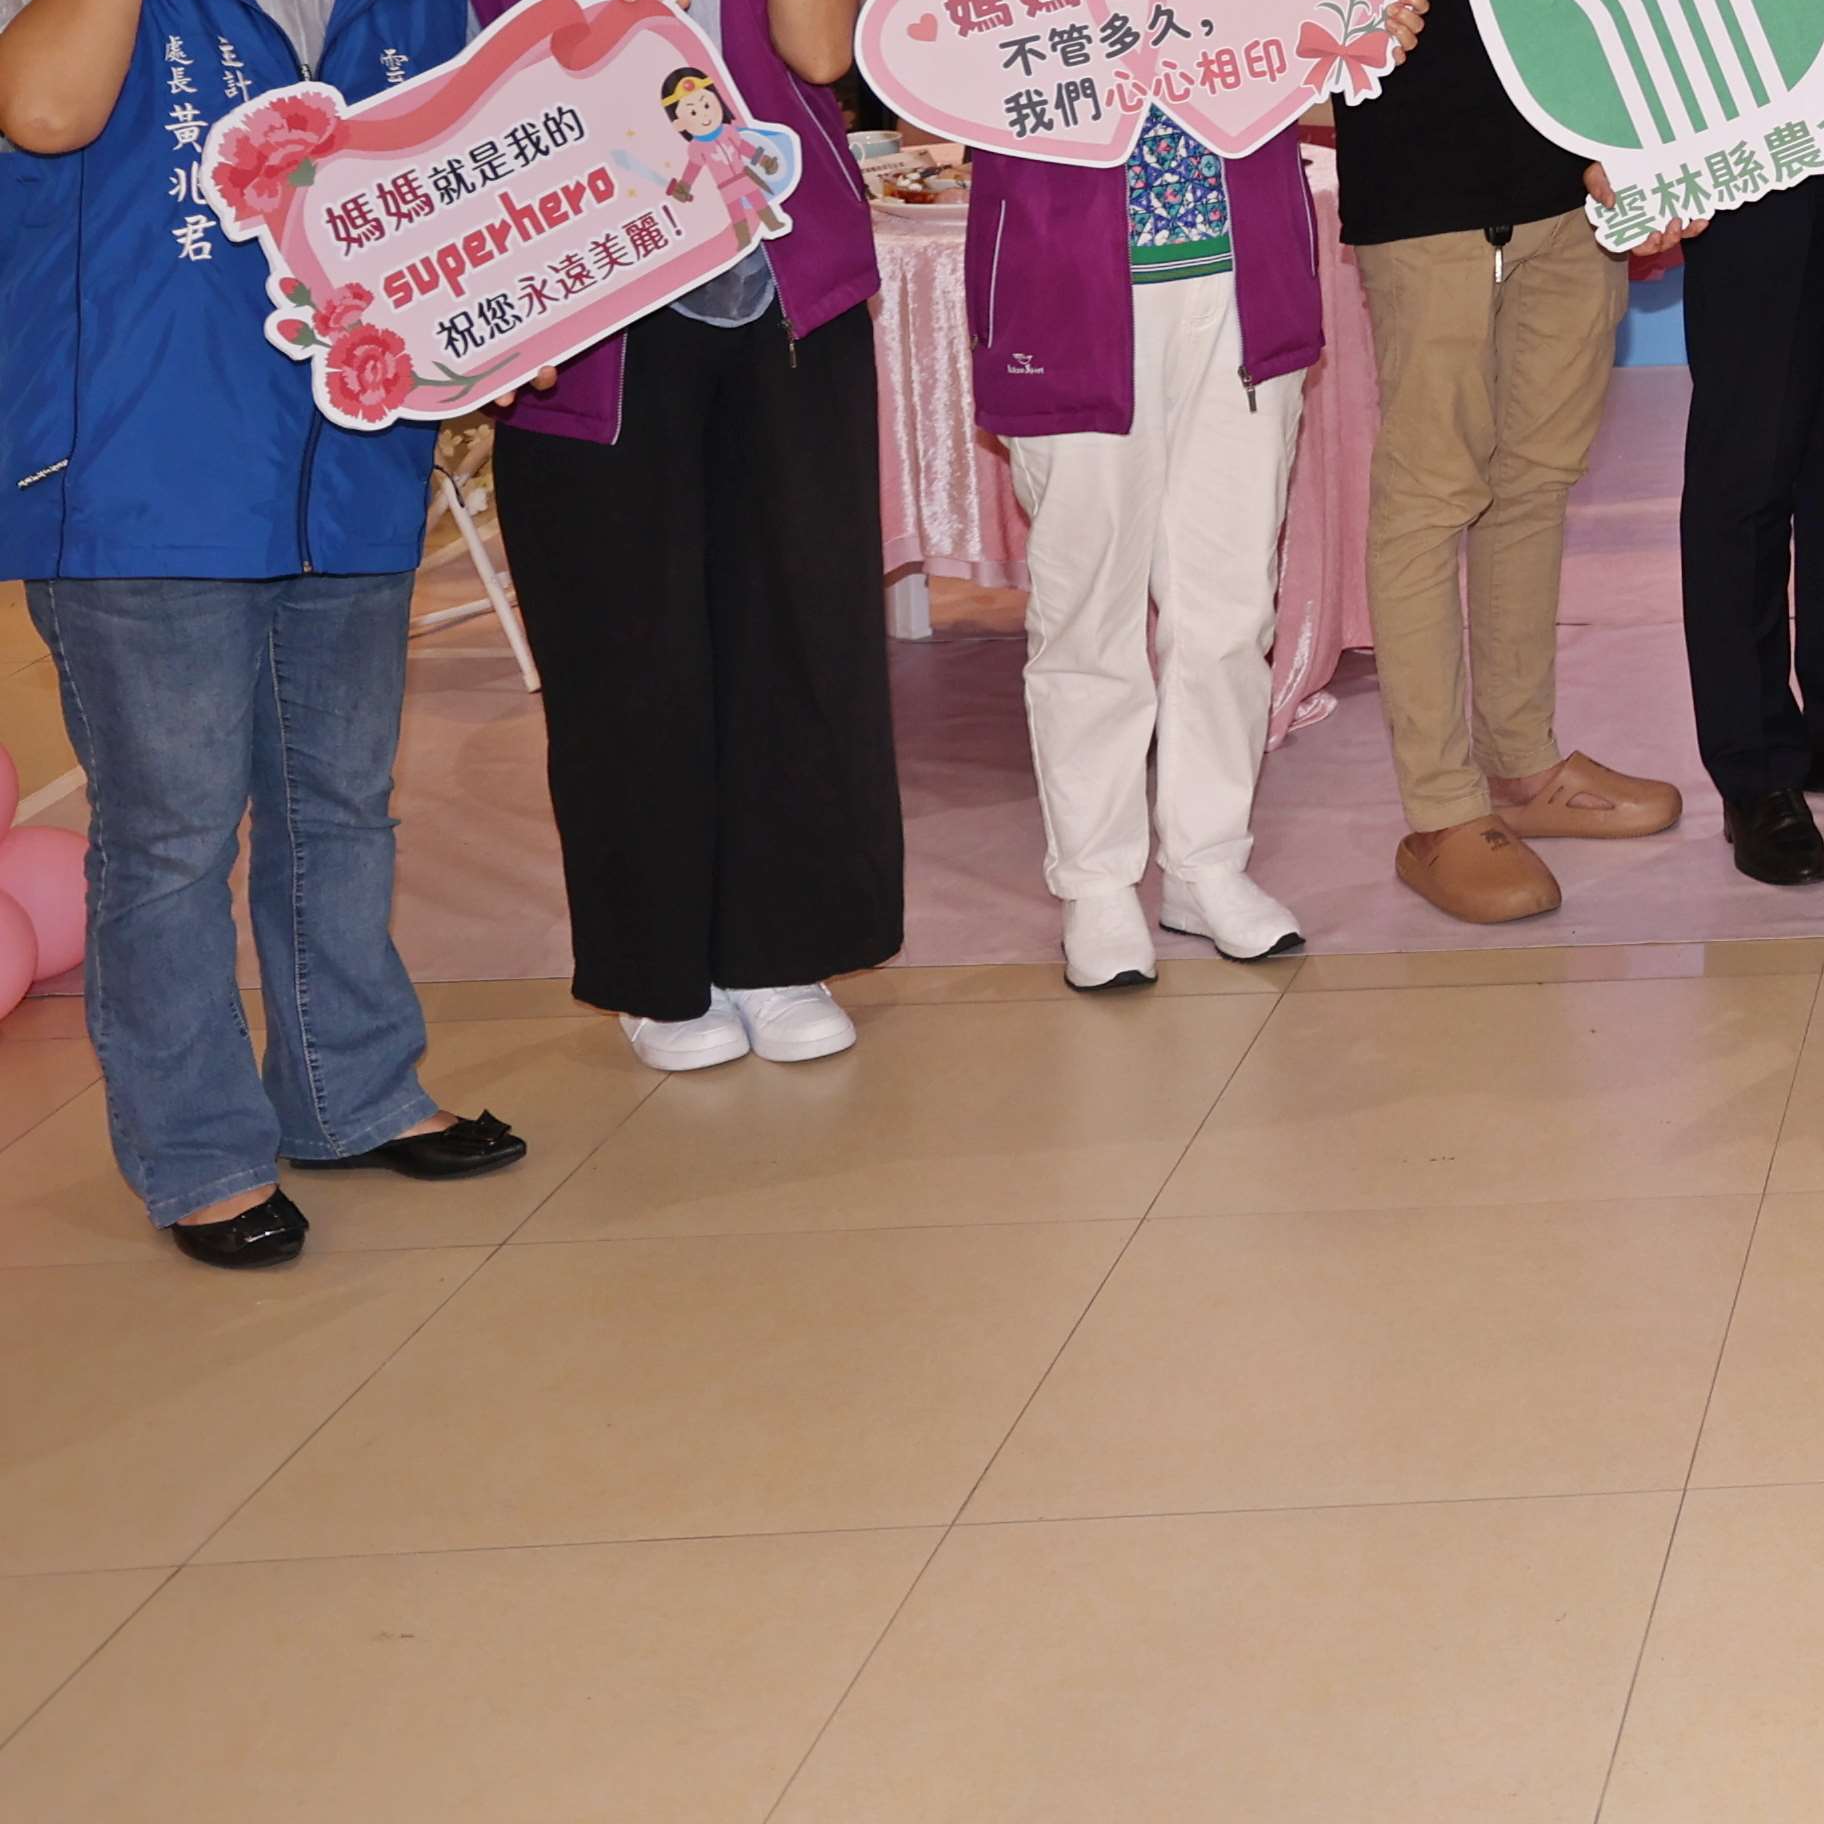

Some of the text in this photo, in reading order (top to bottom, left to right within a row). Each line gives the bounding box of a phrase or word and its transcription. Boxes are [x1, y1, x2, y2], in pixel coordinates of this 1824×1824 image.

[1002, 38, 1287, 139] 我們心心相印
[325, 107, 586, 256] 媽媽就是我的
[381, 166, 616, 310] superhero
